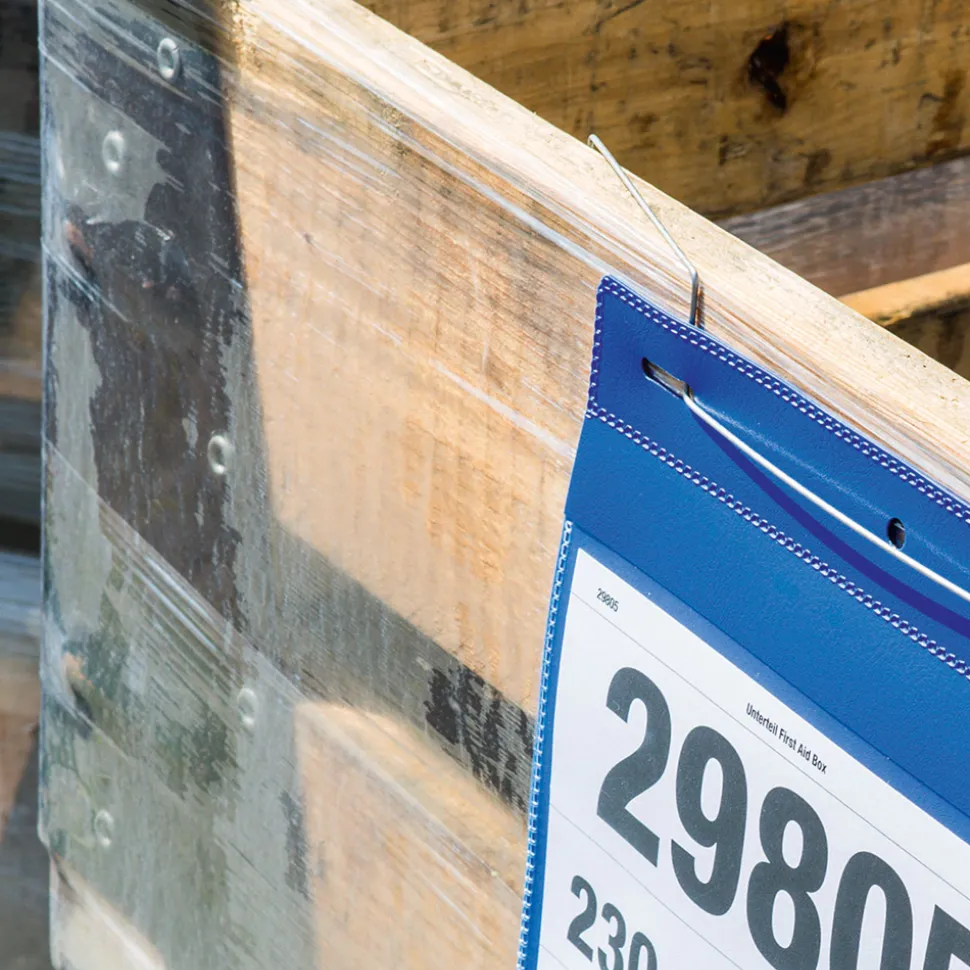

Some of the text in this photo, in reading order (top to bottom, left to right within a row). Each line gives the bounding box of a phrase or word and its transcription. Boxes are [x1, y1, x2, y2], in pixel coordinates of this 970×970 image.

[596, 588, 619, 612] 29805
[746, 702, 828, 774] Unterteil First Aid Box
